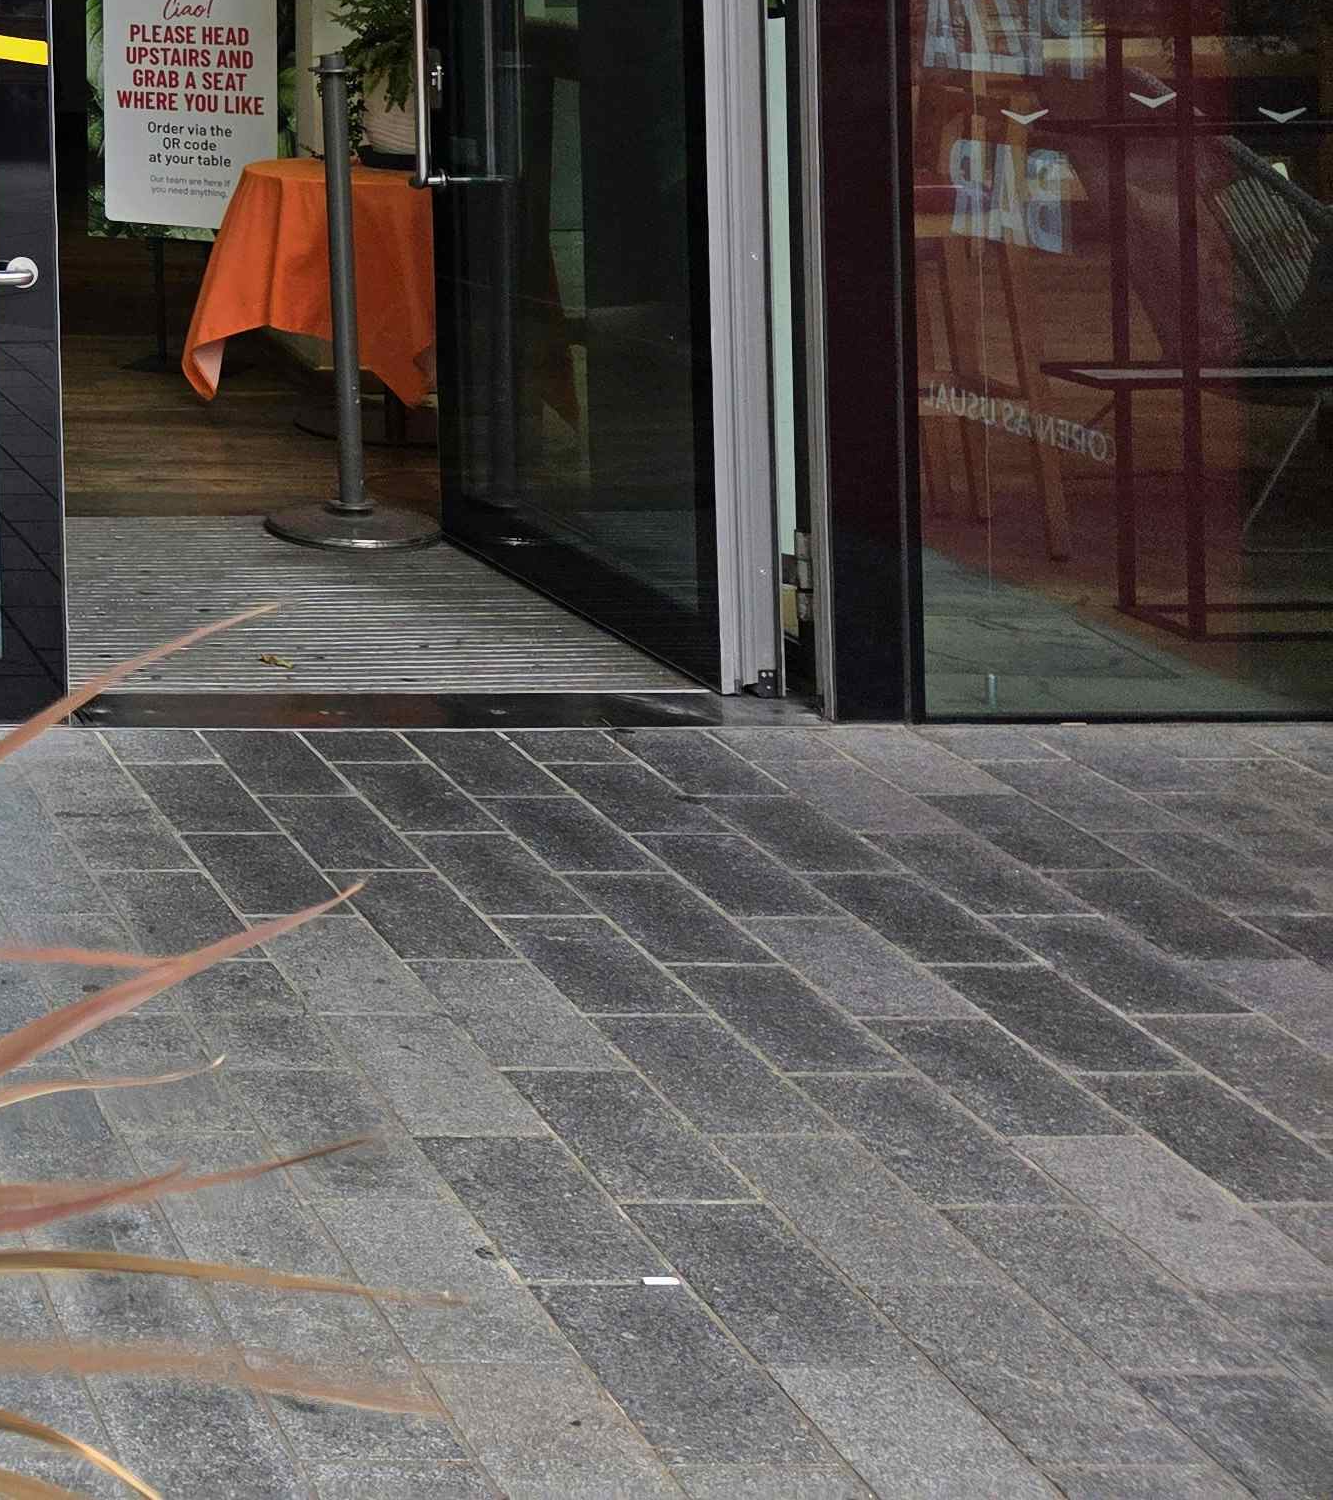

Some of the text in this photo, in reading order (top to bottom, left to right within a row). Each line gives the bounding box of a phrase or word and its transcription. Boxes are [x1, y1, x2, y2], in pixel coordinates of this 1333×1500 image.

[130, 24, 249, 45] PLEASE HEAD
[126, 46, 253, 69] UPSTAIRS AND
[133, 69, 247, 91] GRAB A SEAT
[117, 90, 264, 115] WHERE YOU LIKE
[148, 121, 232, 137] Order via the
[163, 137, 217, 151] QR code
[149, 153, 231, 167] at your table
[166, 176, 187, 184] team
[203, 178, 222, 187] here
[151, 186, 166, 195] you
[168, 187, 188, 195] need
